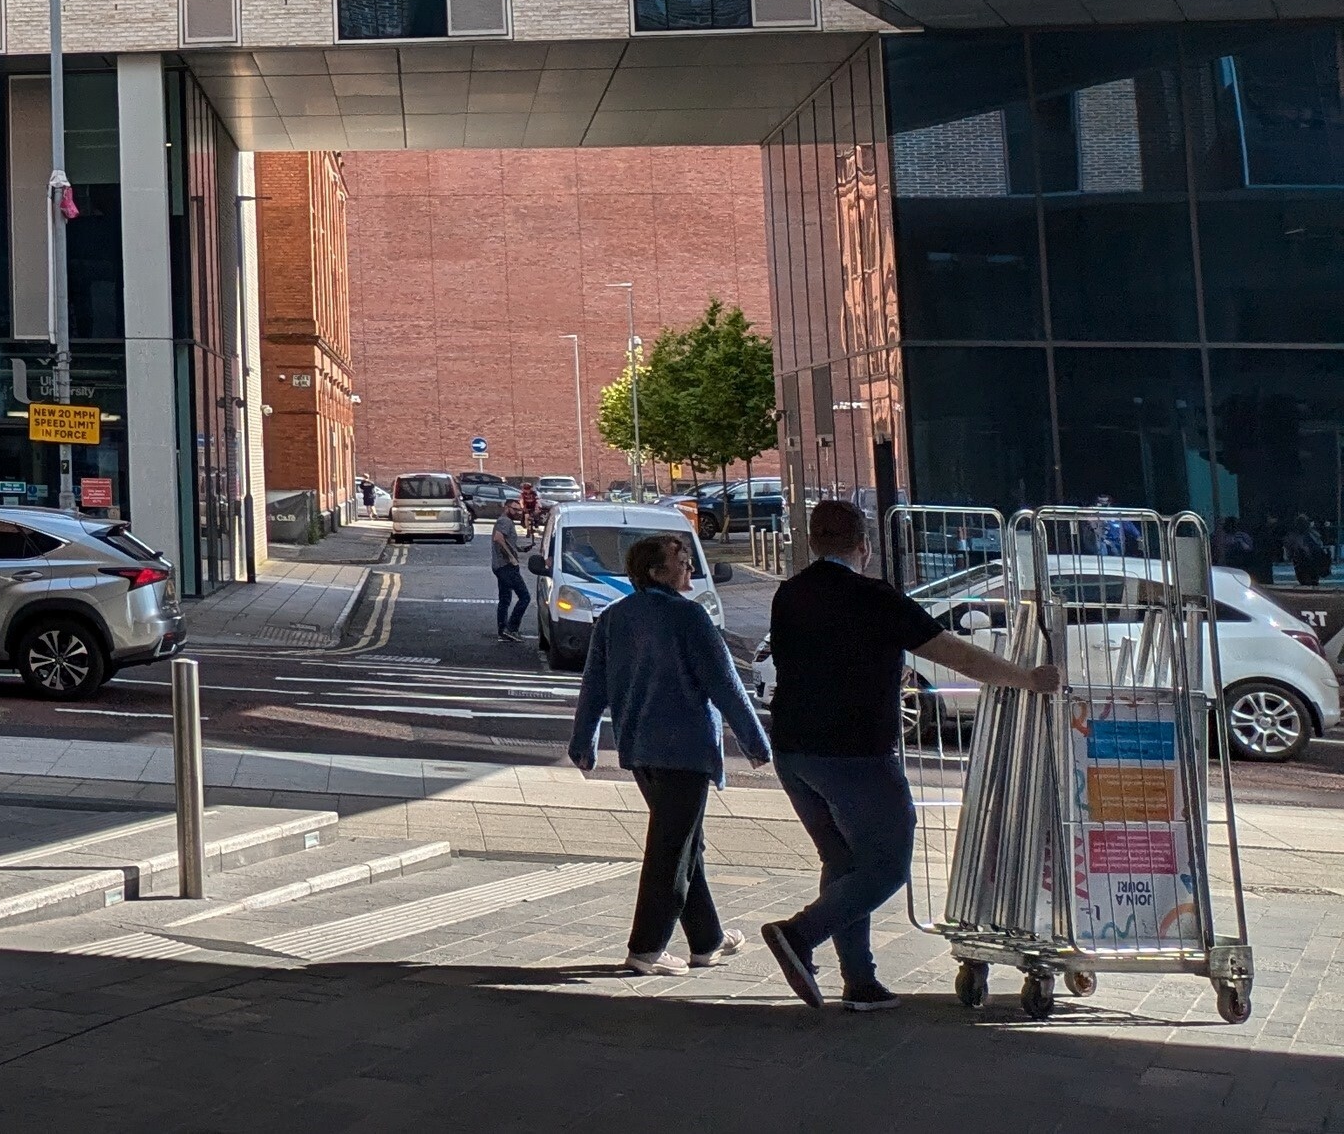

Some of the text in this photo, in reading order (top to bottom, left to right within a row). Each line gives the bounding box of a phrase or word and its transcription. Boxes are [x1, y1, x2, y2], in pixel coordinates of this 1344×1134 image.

[34, 408, 96, 419] NEW 20 MPH
[34, 419, 96, 430] SPEED LIMIT
[42, 429, 87, 440] IN FORCE
[1117, 881, 1151, 893] TOUR!
[1116, 893, 1152, 906] JOIN A
